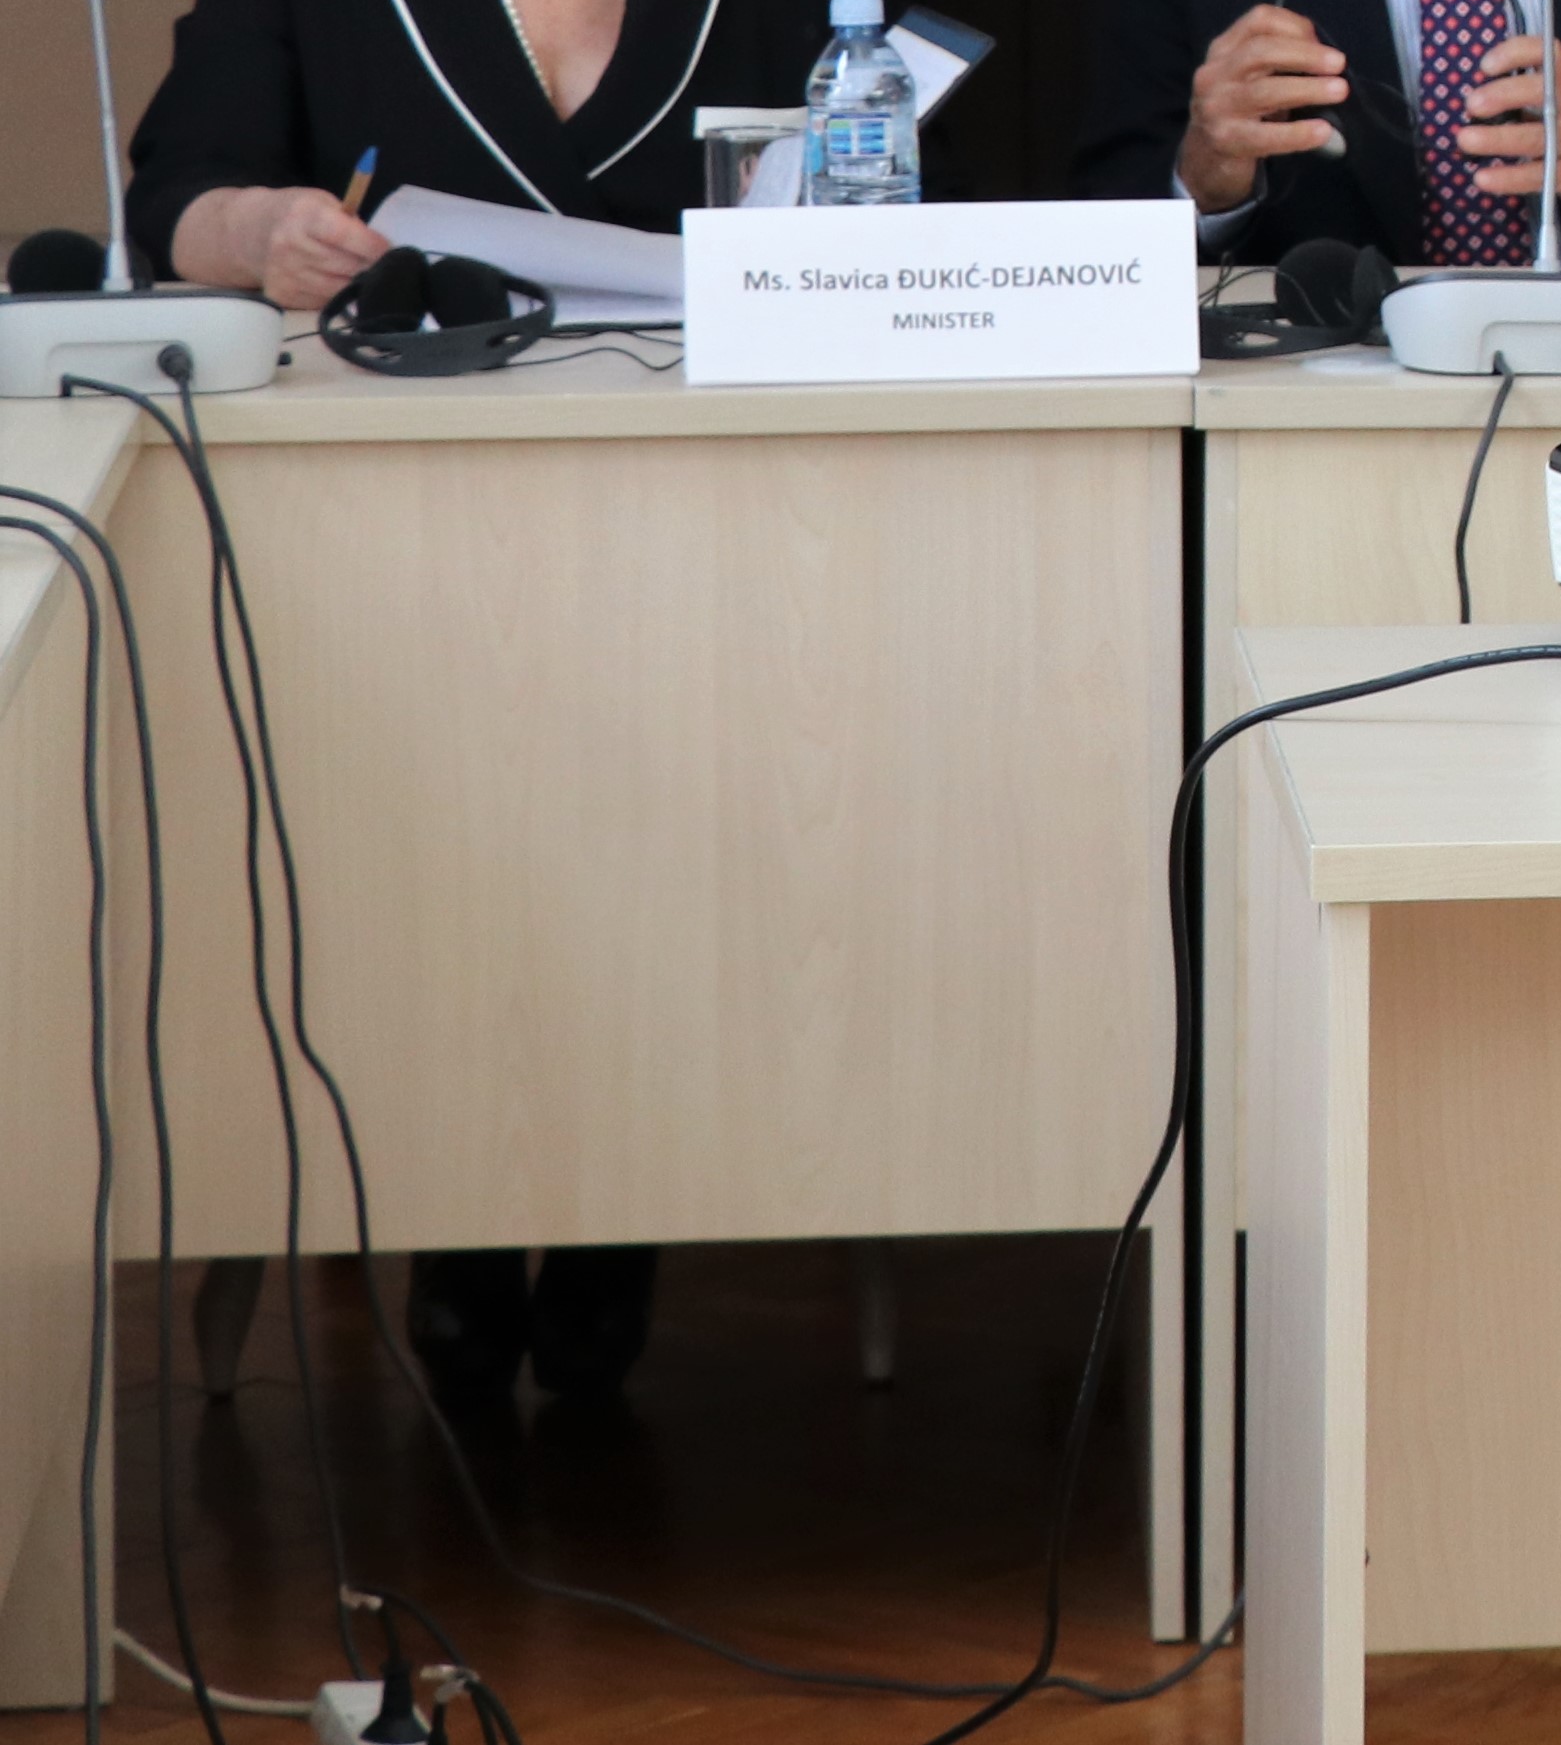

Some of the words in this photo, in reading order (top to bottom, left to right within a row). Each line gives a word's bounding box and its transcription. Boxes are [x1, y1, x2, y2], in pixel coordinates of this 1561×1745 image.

[743, 269, 791, 291] Ms.
[799, 268, 890, 292] Slavica
[896, 258, 1142, 291] ĐUKIĆ-DEJANOVIĆ
[892, 311, 995, 330] MINISTER
